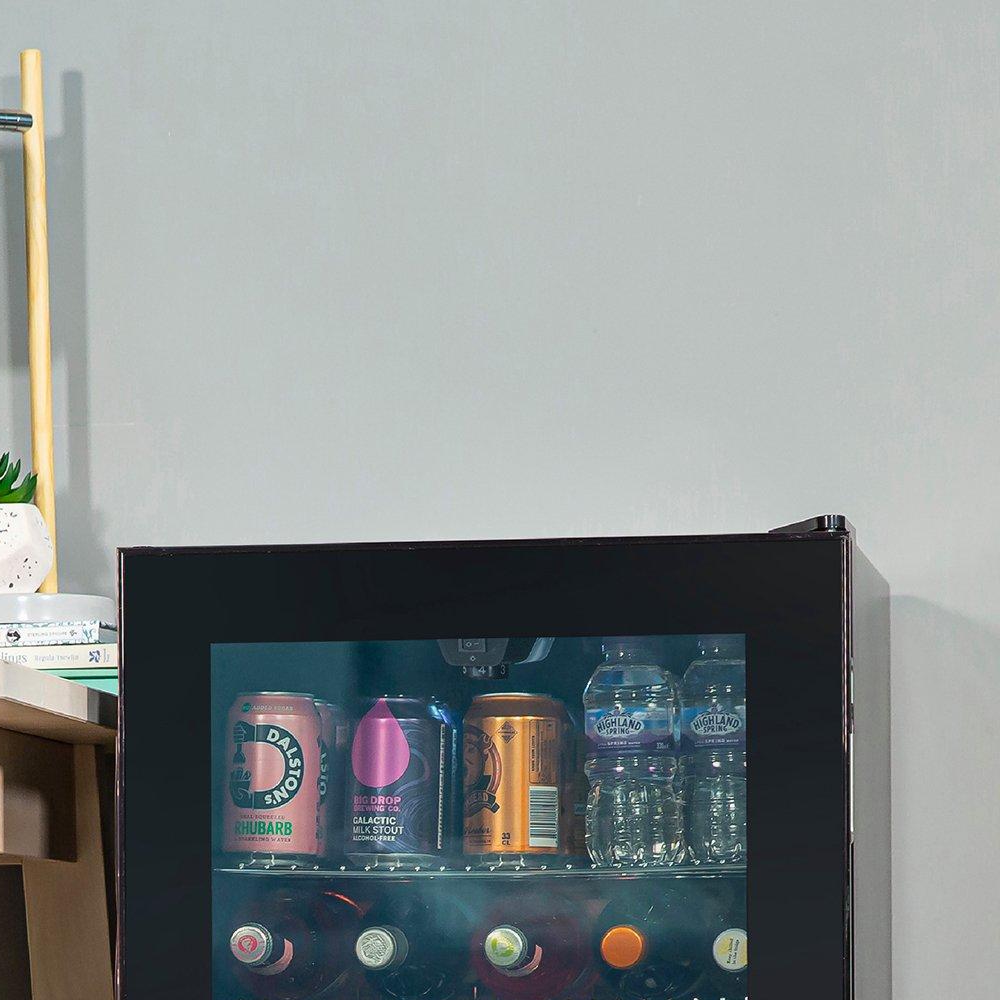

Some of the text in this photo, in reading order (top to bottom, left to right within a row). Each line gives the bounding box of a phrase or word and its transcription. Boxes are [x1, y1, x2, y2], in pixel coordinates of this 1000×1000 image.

[596, 717, 642, 733] HIGHLAND
[693, 716, 740, 733] HIGHLAND
[703, 725, 728, 733] SPRING
[606, 727, 630, 735] SPRING
[354, 796, 401, 805] BIG DROP
[353, 816, 396, 825] GALACTIC
[234, 821, 293, 836] RHUBARB
[353, 826, 404, 834] MILK STOUT
